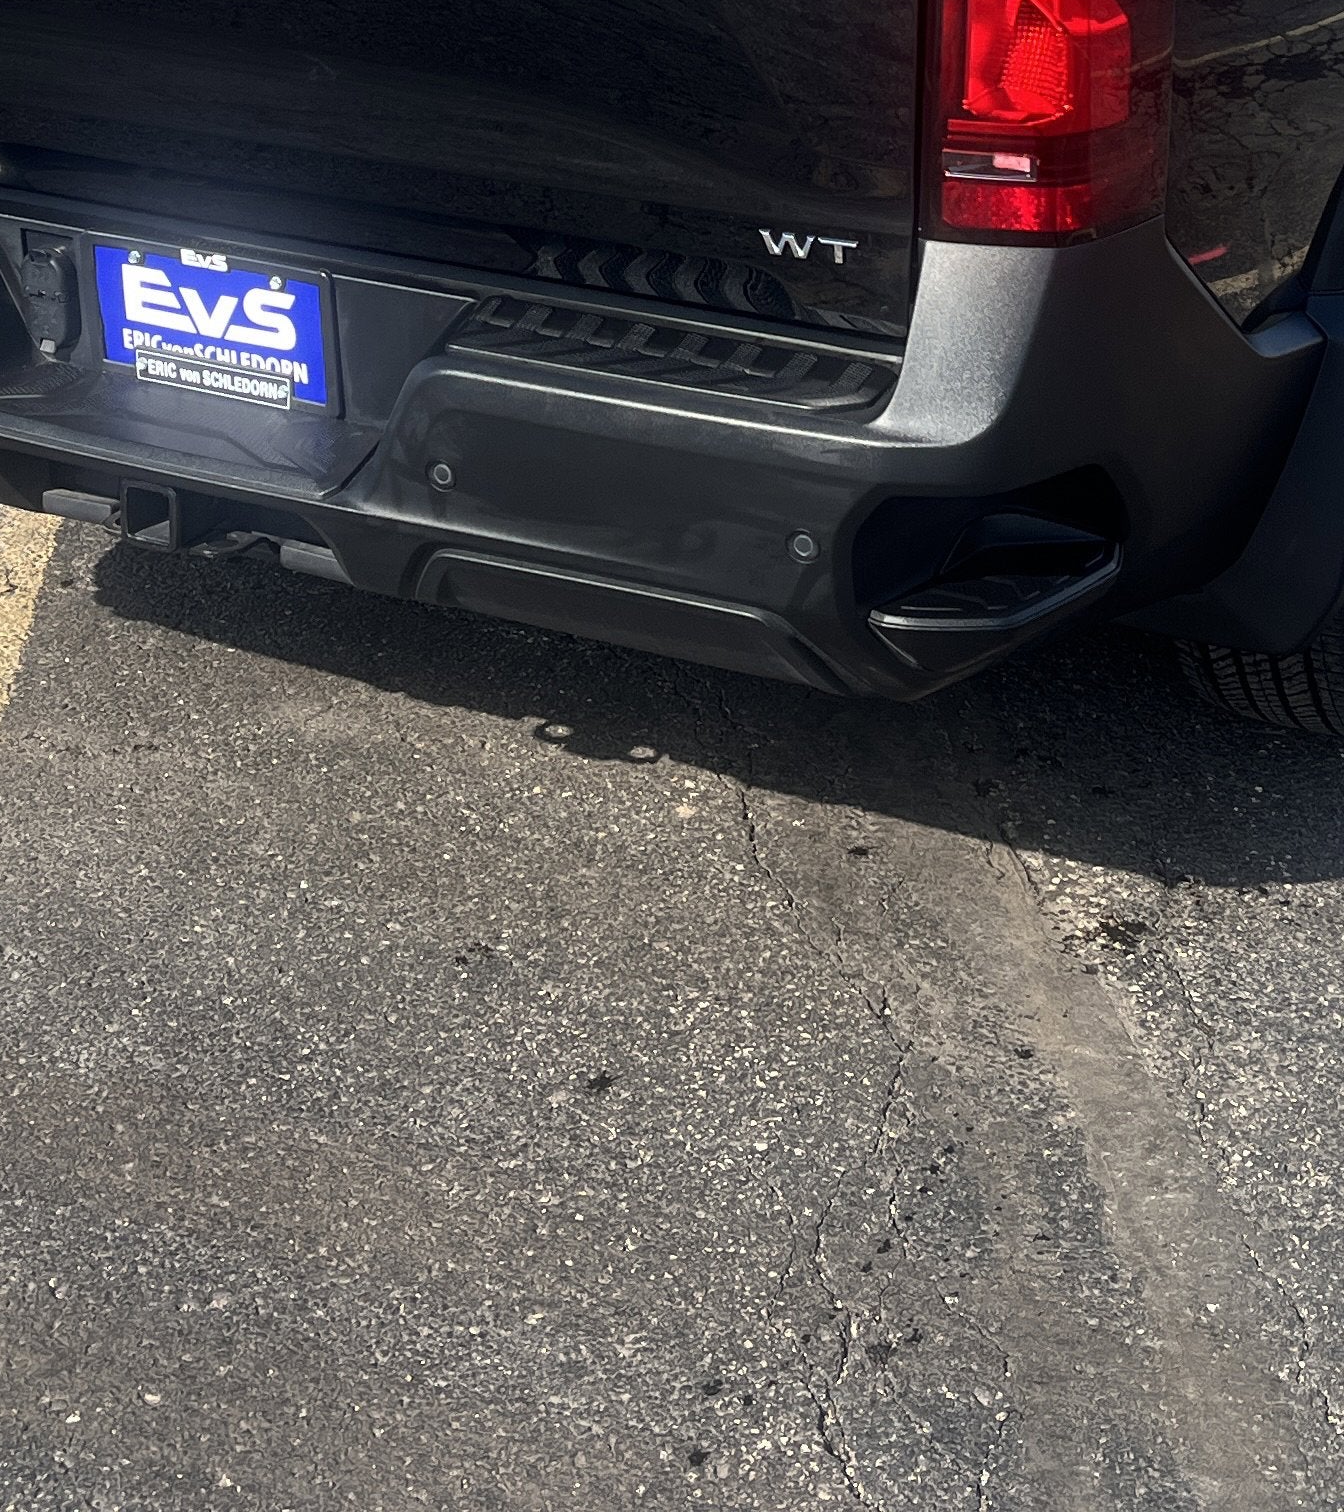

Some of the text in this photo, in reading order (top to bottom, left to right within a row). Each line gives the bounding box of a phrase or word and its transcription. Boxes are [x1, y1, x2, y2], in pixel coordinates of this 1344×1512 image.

[759, 228, 859, 264] WT
[147, 359, 279, 400] ERIC von SCHLEDORN
